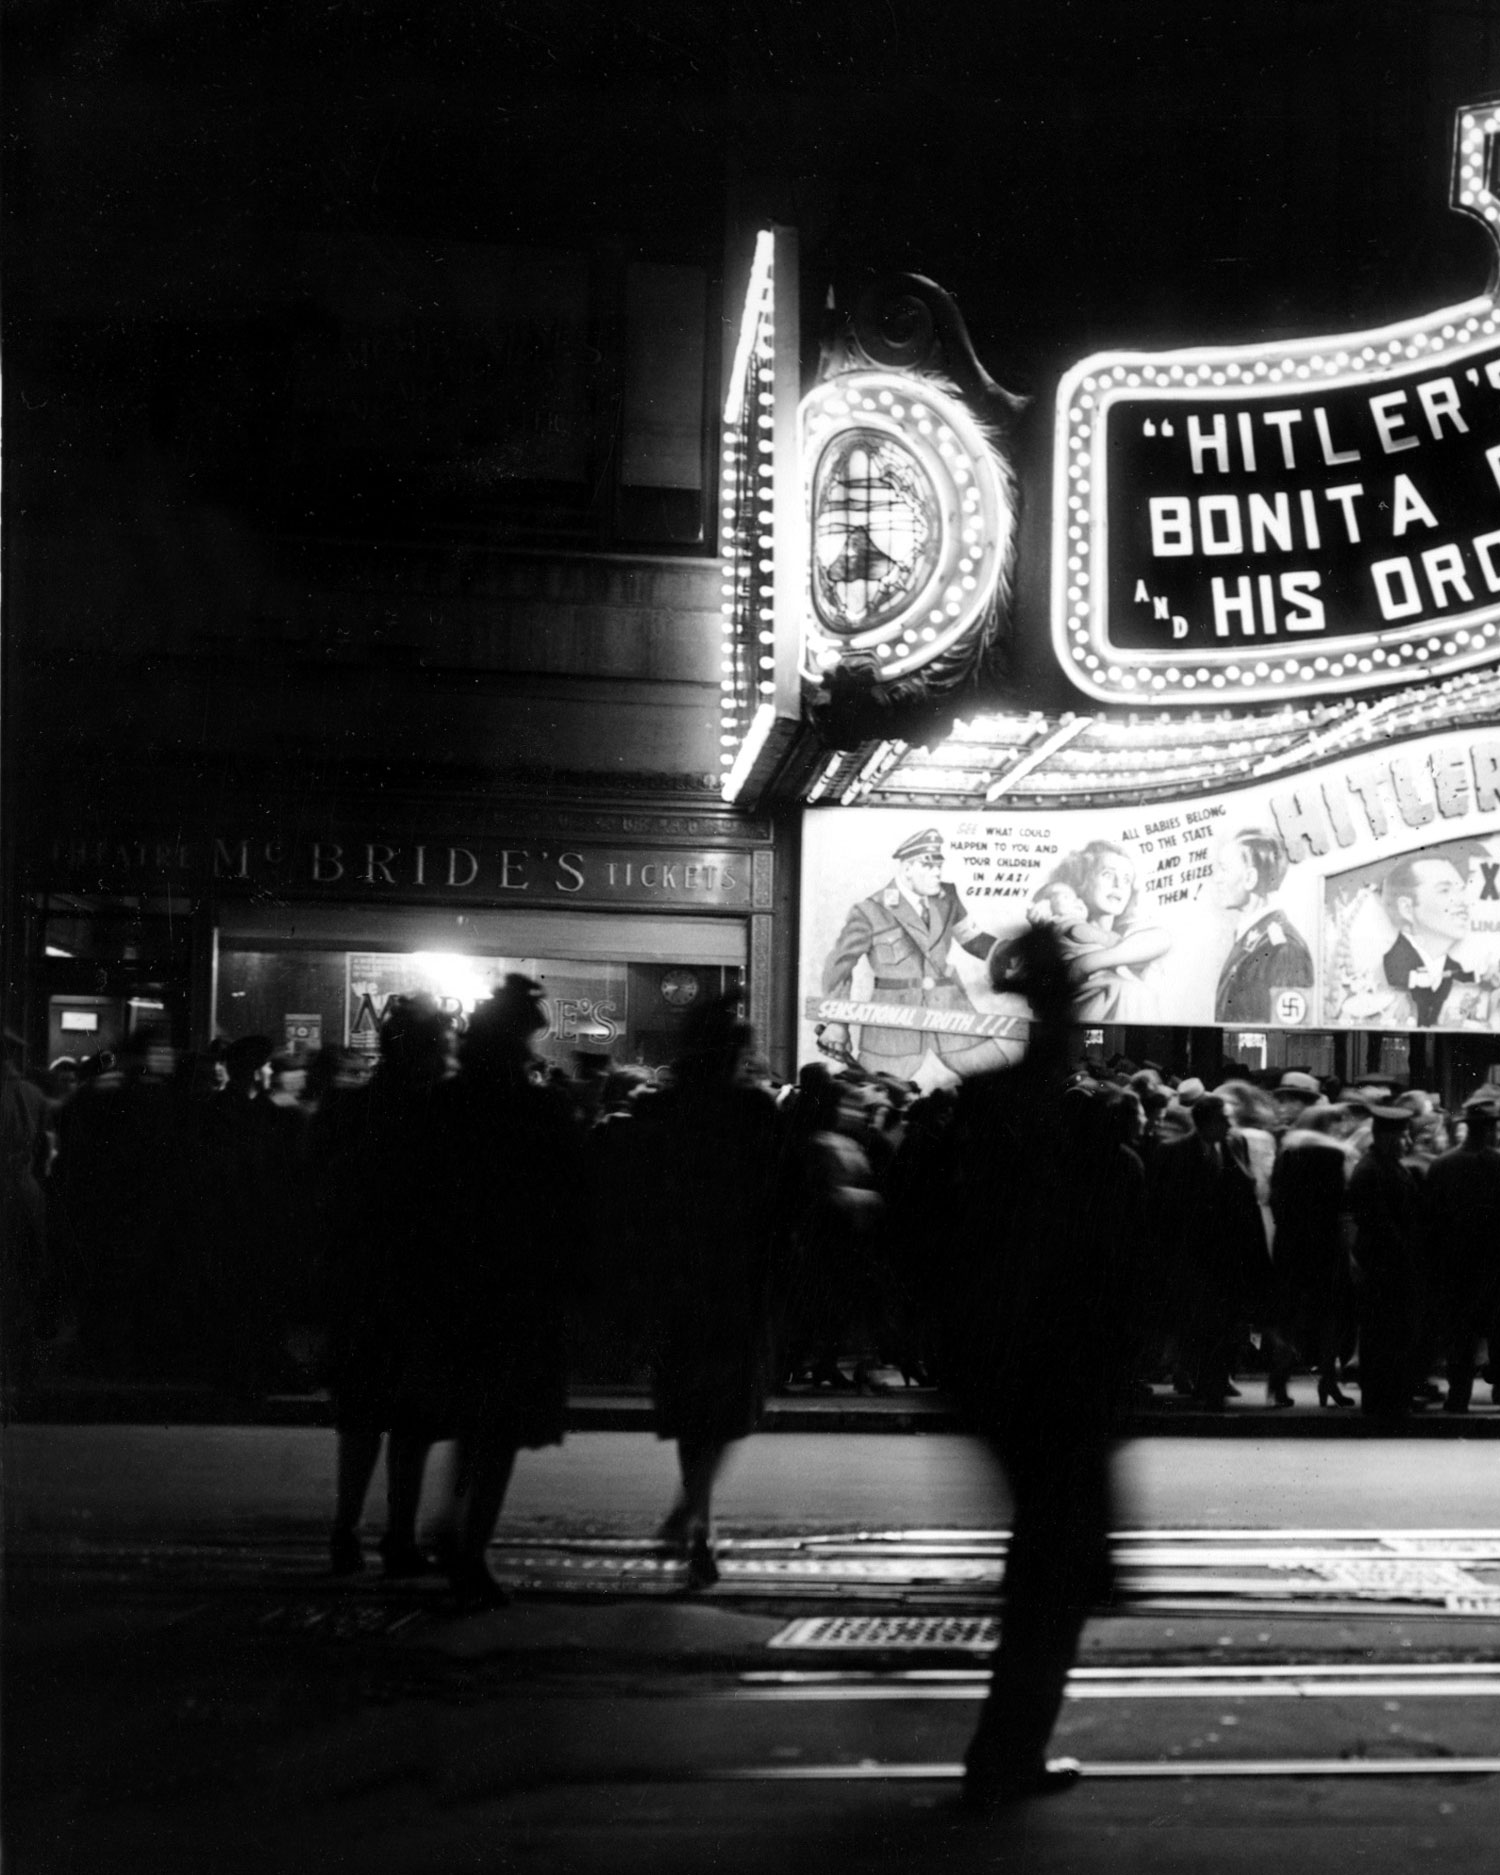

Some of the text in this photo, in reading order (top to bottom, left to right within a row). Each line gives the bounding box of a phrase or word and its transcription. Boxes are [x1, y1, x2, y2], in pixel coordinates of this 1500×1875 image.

[1149, 475, 1437, 557] BONITA
[1134, 579, 1188, 639] AND
[1212, 571, 1325, 636] HIS
[985, 827, 1013, 837] WHAT
[1019, 828, 1051, 838] COULD
[1122, 804, 1227, 842] ALL BABIES BELONG
[950, 841, 1059, 854] HAPPEN TO YOU AND
[1139, 825, 1213, 854] TO THE STATE
[963, 856, 991, 866] YOUR
[1189, 847, 1208, 864] THE
[605, 863, 737, 889] TICKETS
[973, 872, 1030, 883] IN NAZI
[1145, 864, 1213, 893] STATE SEIZES
[966, 886, 1029, 897] GERMANY
[818, 1000, 917, 1026] SENSATIONAL
